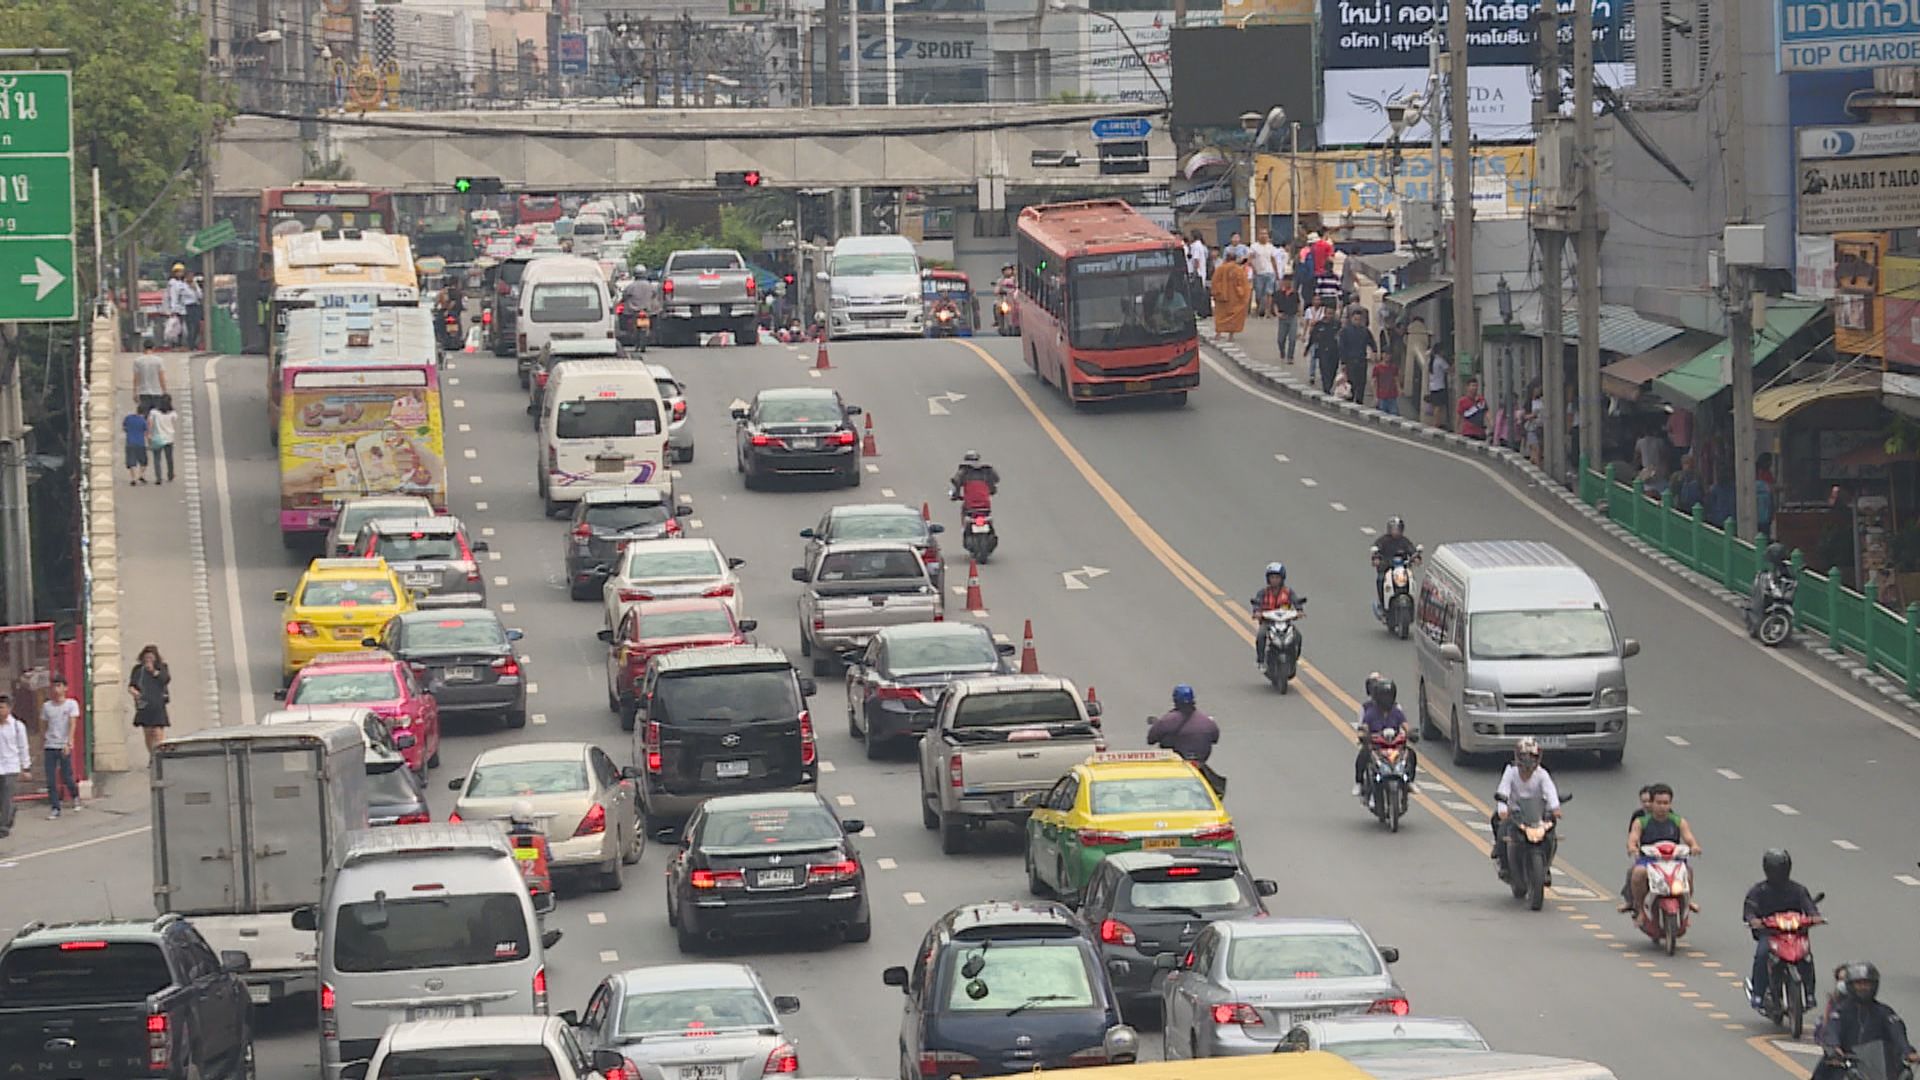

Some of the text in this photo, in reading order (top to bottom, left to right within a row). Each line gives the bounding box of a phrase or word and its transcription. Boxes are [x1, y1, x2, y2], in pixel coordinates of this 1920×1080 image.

[1340, 32, 1379, 47] อโศก
[1391, 28, 1445, 51] สุขุมวิ
[917, 40, 974, 59] SPORT
[1789, 46, 1831, 65] TOP
[1831, 172, 1875, 191] AMARI
